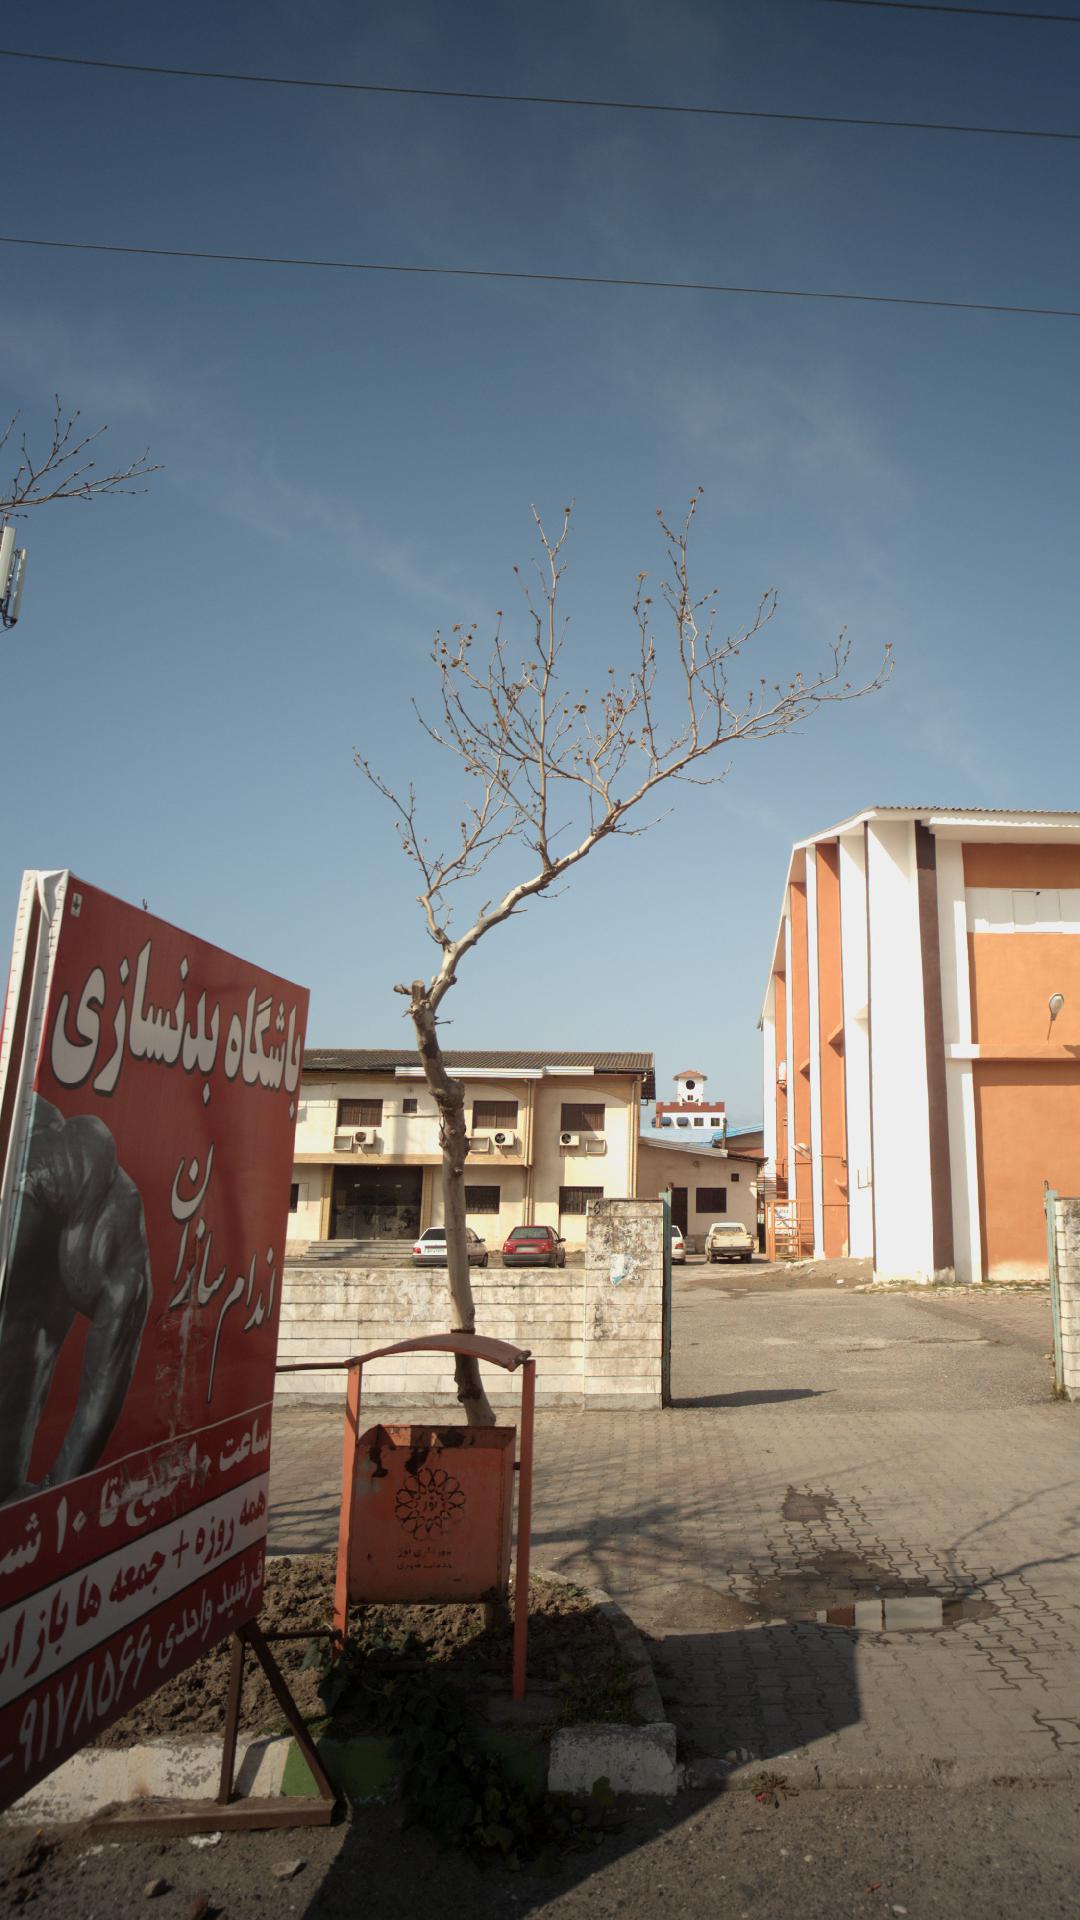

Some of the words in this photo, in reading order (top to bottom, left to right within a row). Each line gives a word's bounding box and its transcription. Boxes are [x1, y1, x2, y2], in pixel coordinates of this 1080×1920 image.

[51, 938, 221, 1106] بدنسازی
[223, 986, 301, 1121] باشگاه
[169, 1143, 228, 1308] سازان
[206, 1247, 277, 1403] اندام
[219, 1418, 270, 1472] ساعت
[56, 1496, 88, 1554] ۱۰
[239, 1490, 266, 1526] همه
[195, 1515, 234, 1565] روزه
[76, 1574, 102, 1627] ها
[109, 1551, 166, 1602] جمعه
[24, 1587, 69, 1679] باز
